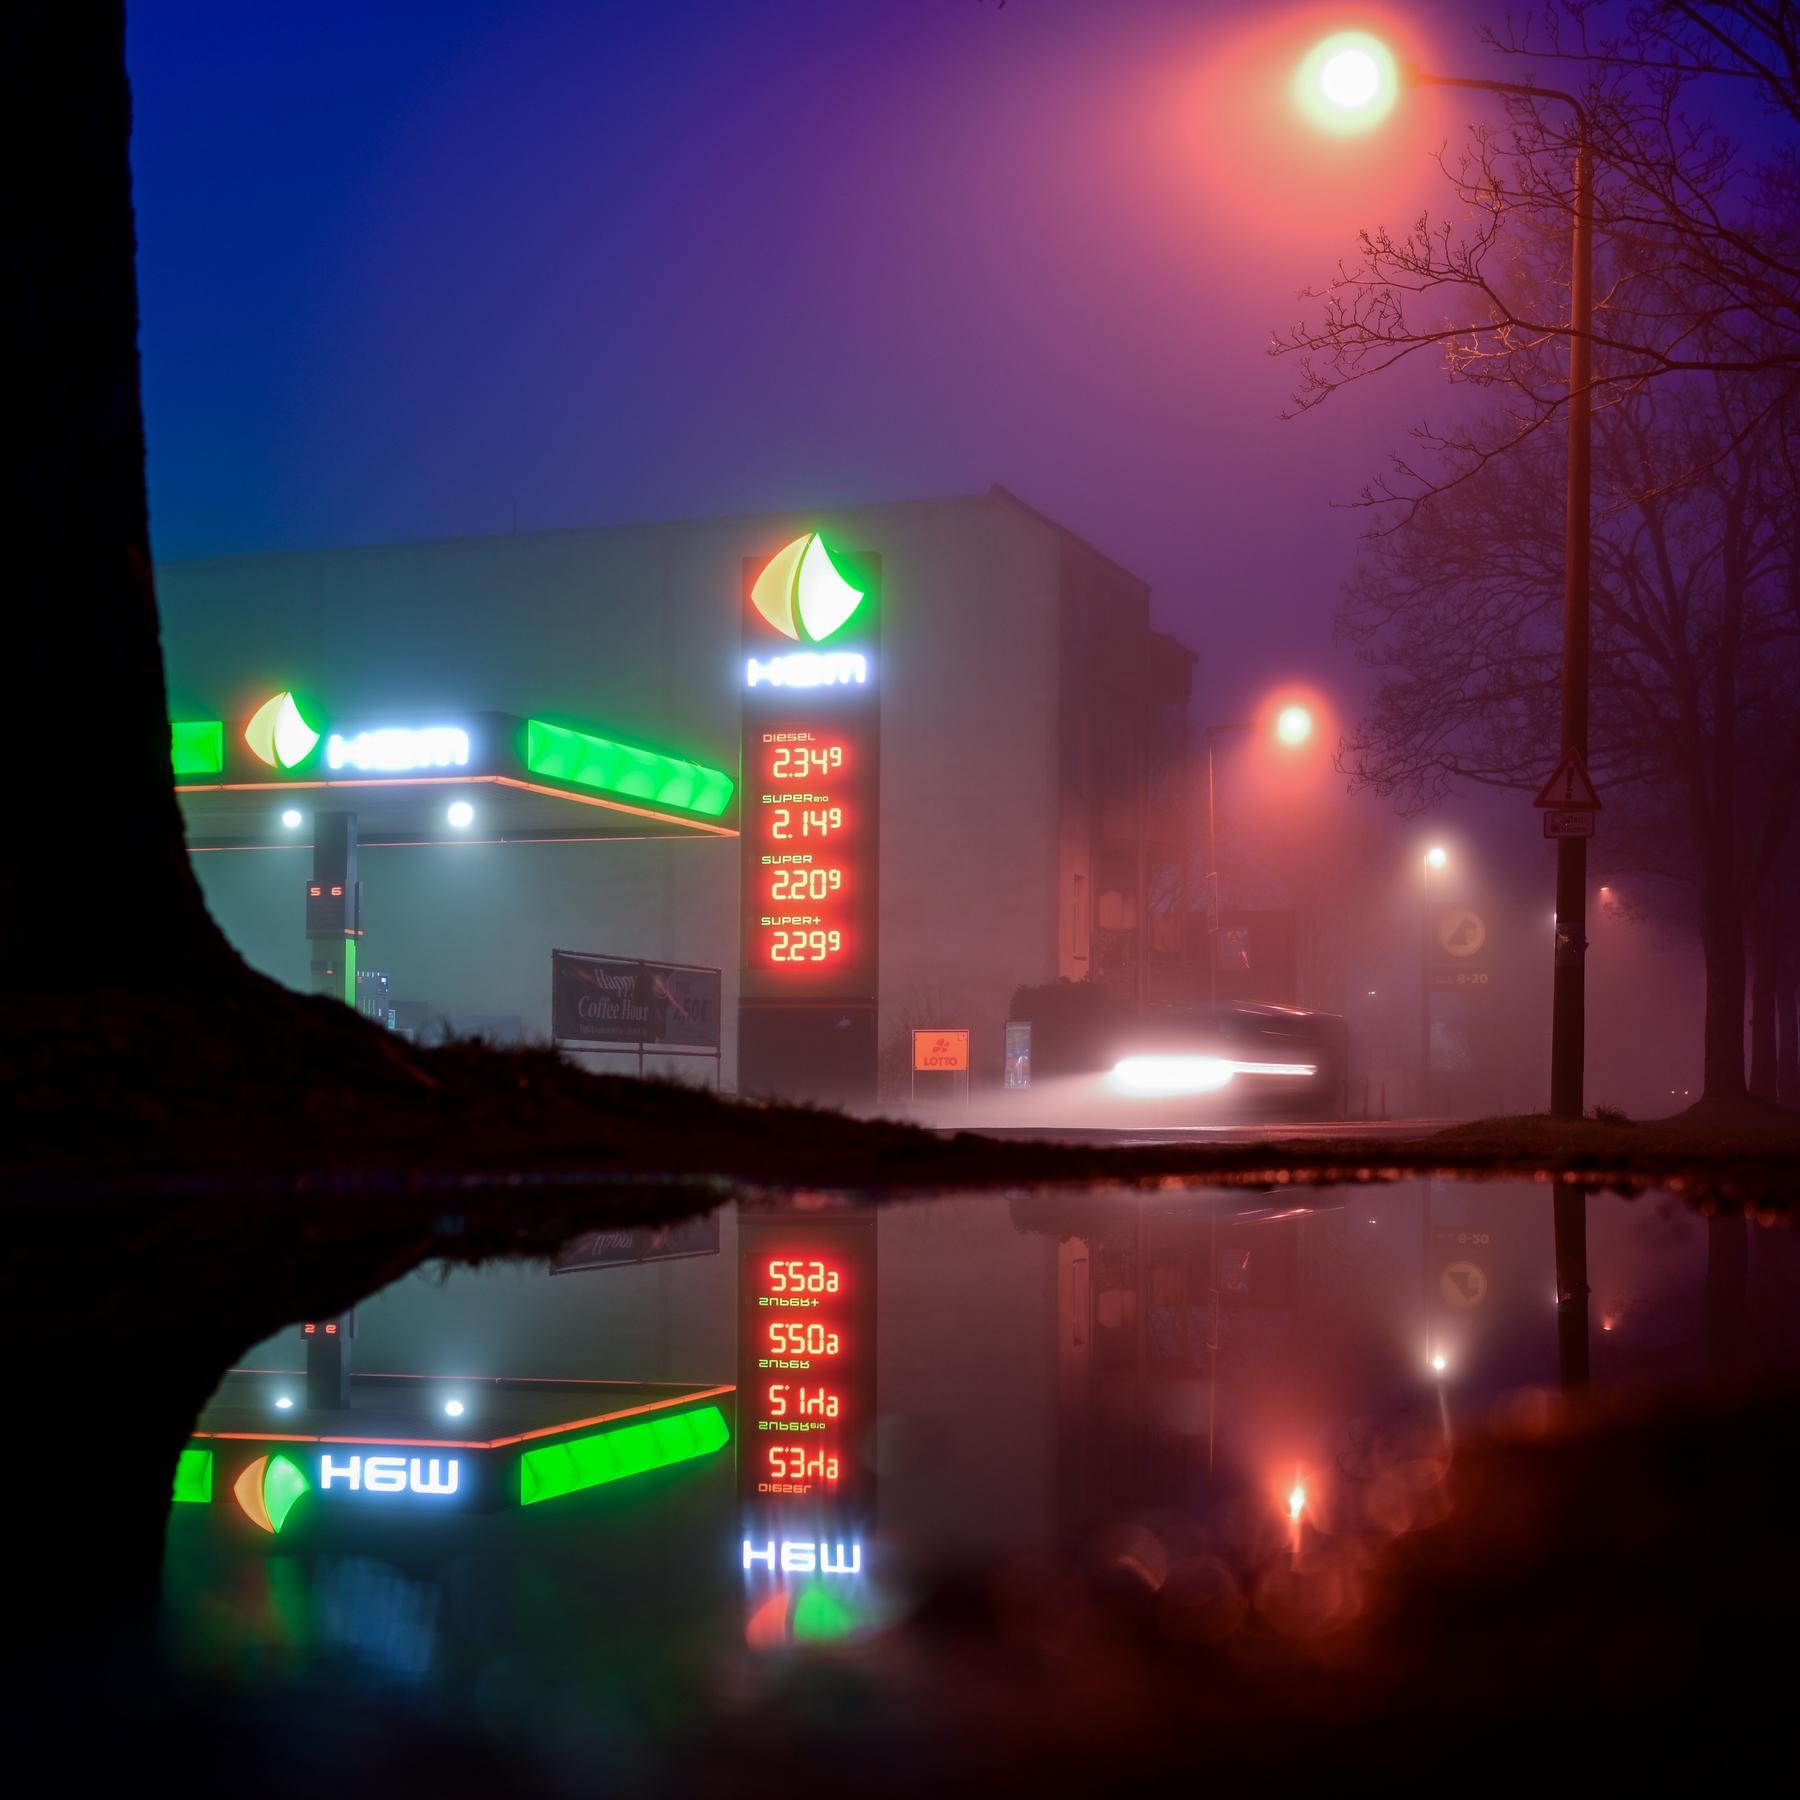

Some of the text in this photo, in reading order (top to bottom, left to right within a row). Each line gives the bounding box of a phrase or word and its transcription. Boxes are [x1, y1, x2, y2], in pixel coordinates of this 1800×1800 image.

[762, 733, 816, 743] DIESEL
[772, 747, 842, 778] 2.349
[772, 808, 842, 839] 2.149
[761, 855, 813, 865] SUPER
[331, 887, 343, 896] 6
[771, 869, 841, 900] 2.209
[760, 916, 822, 926] SUPER+
[771, 930, 841, 961] 2.299
[594, 968, 637, 998] Happy
[1457, 974, 1488, 984] 8-20
[577, 995, 649, 1021] Coffee Hour
[924, 1057, 958, 1066] LOTTO
